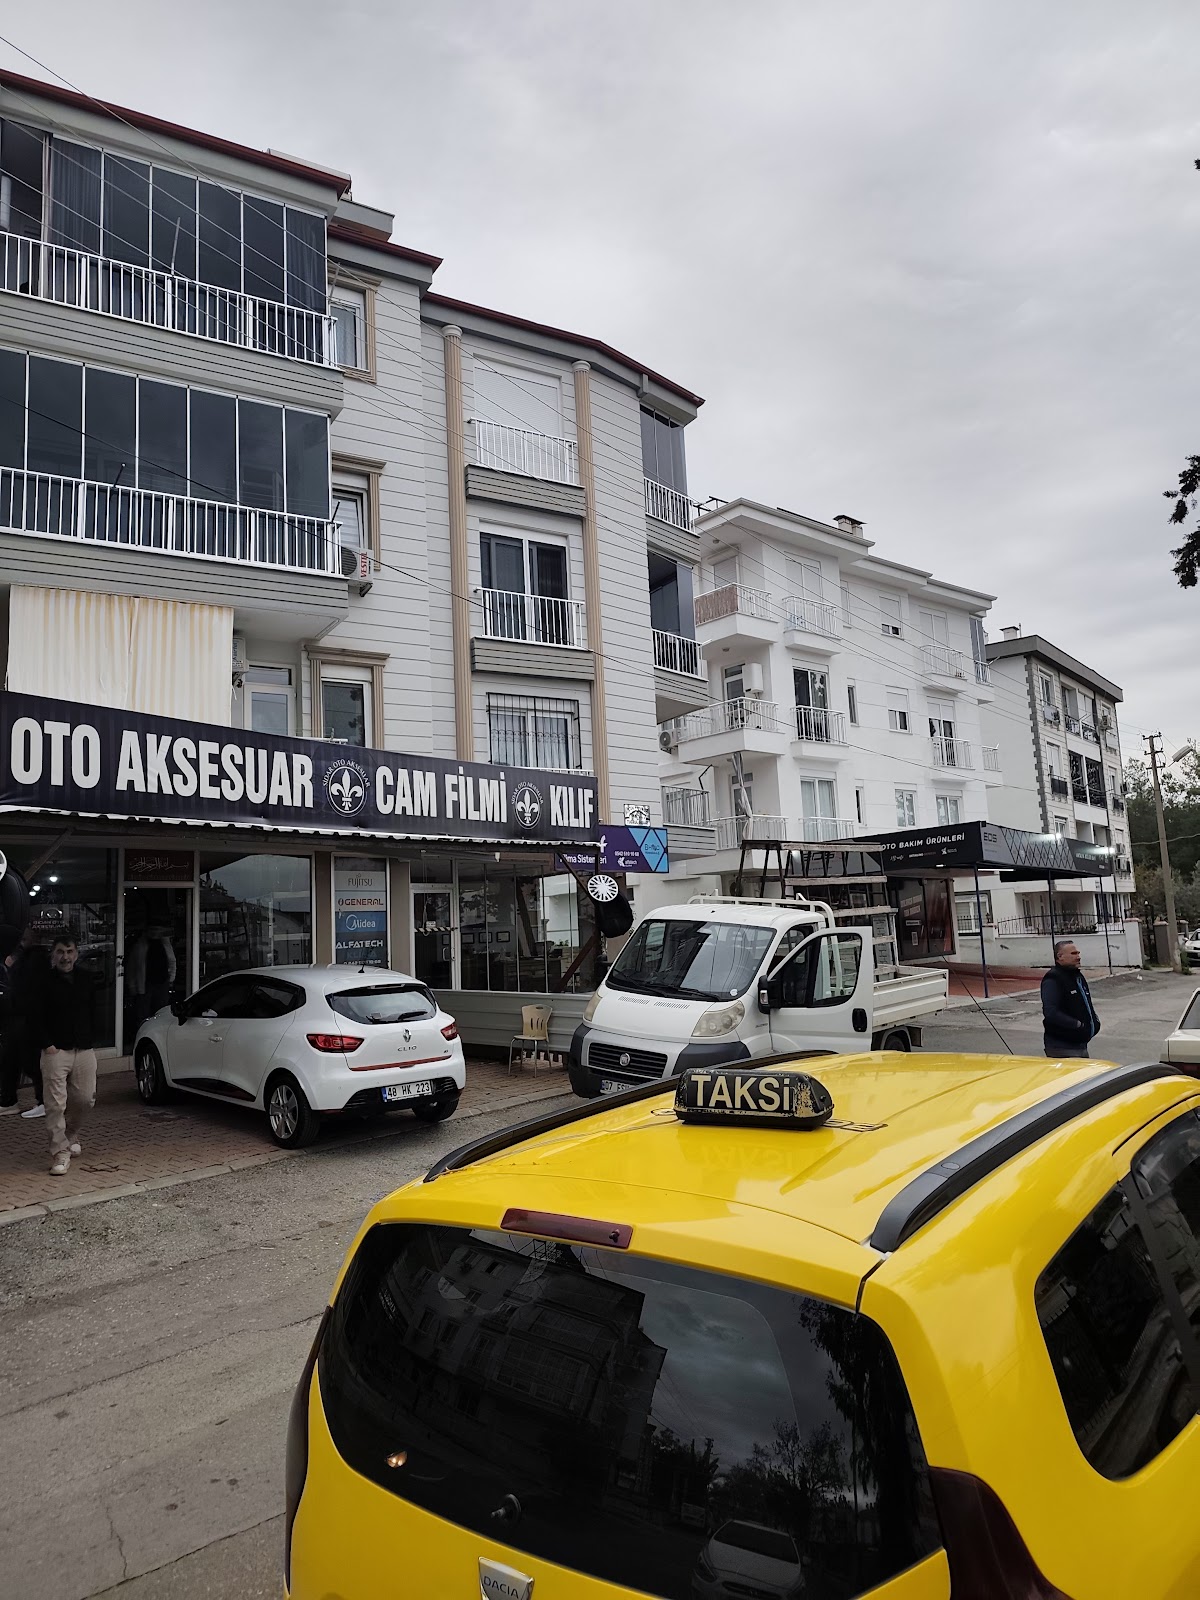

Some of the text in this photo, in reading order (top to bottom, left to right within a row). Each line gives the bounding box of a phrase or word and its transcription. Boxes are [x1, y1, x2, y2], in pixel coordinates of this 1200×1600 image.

[11, 717, 314, 808] OTO AKSESUAR
[375, 766, 508, 823] CAM FİLMİ
[549, 785, 594, 829] KILIF
[881, 832, 965, 851] OTO BAKIM ÜRÜNLERİ
[347, 877, 373, 888] FUJITSU
[344, 898, 384, 906] GENERAL
[349, 917, 376, 929] Midea
[335, 940, 384, 949] ALFATECH
[387, 1082, 430, 1098] 48 HK 223
[483, 1575, 519, 1599] DACIA
